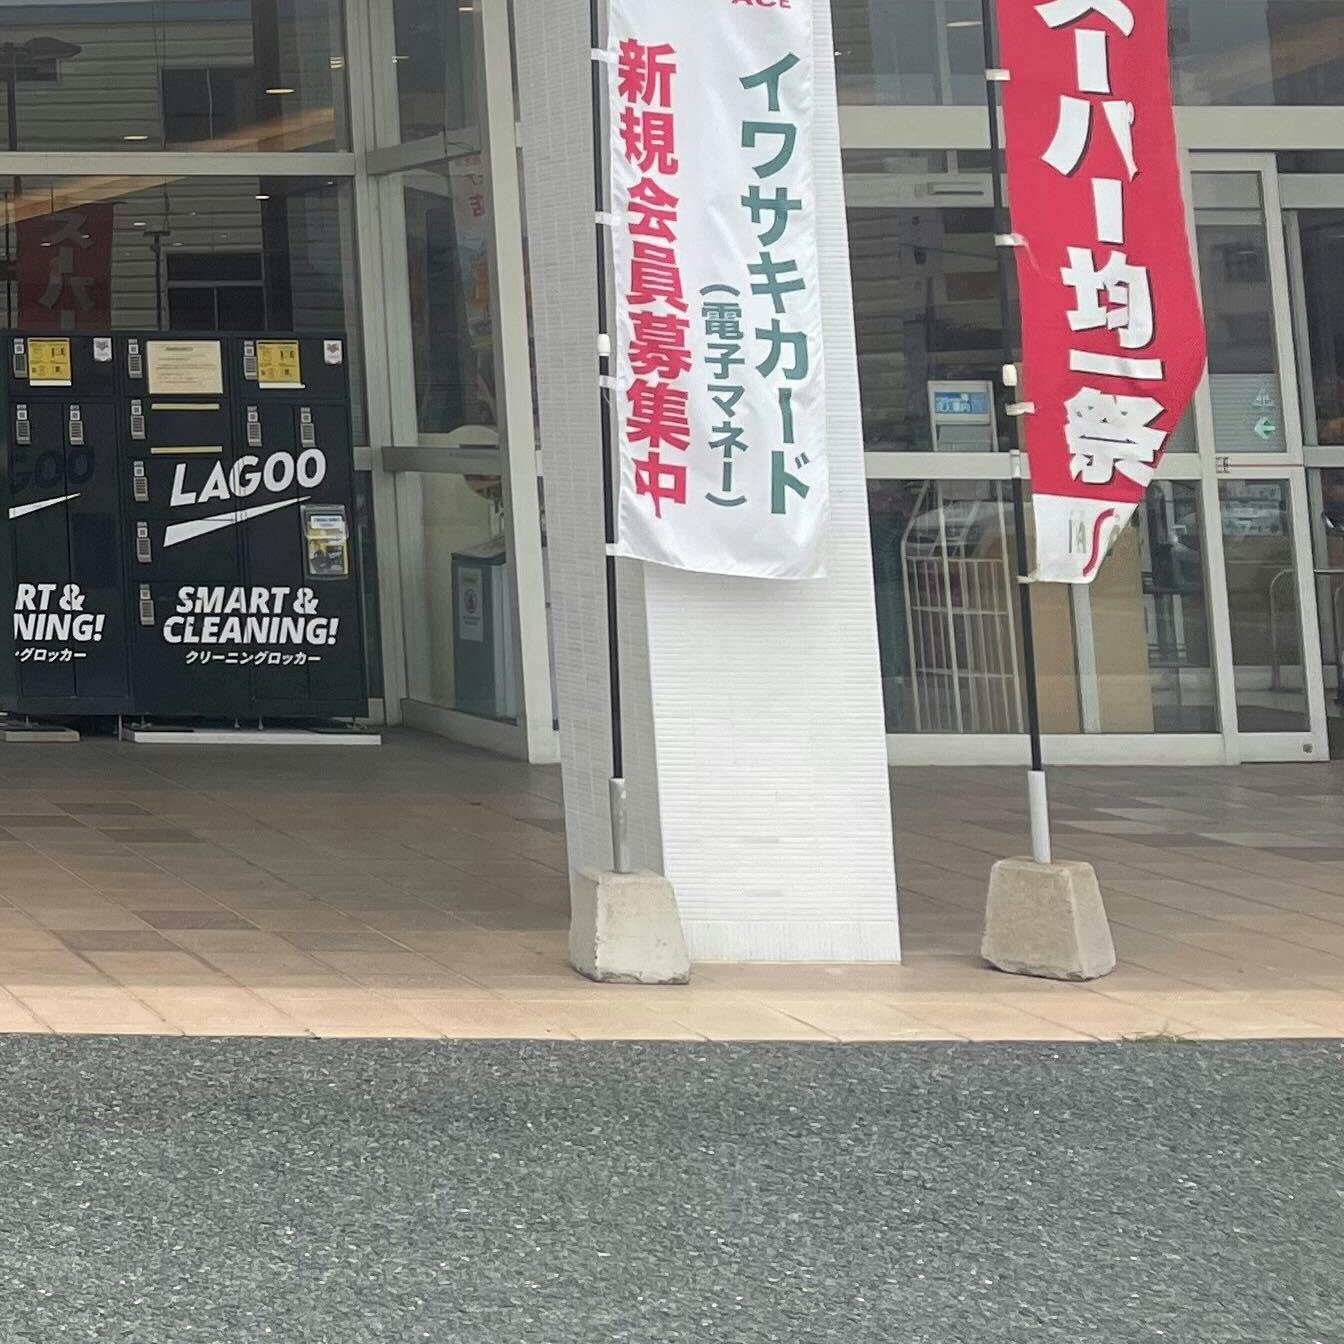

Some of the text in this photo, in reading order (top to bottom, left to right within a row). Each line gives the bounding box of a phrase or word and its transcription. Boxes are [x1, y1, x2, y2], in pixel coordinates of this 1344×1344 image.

[617, 37, 692, 520] 新規会員募集中
[738, 52, 811, 515] イワサキカード
[699, 283, 748, 509] （電子マネー）
[170, 447, 327, 507] LAGOO
[14, 583, 86, 611] RT &
[176, 585, 320, 615] SMART &
[13, 614, 106, 641] NING!
[162, 616, 340, 645] CLEANING!
[14, 647, 87, 663] グロッカー
[185, 650, 322, 665] クリーニングロッカー
